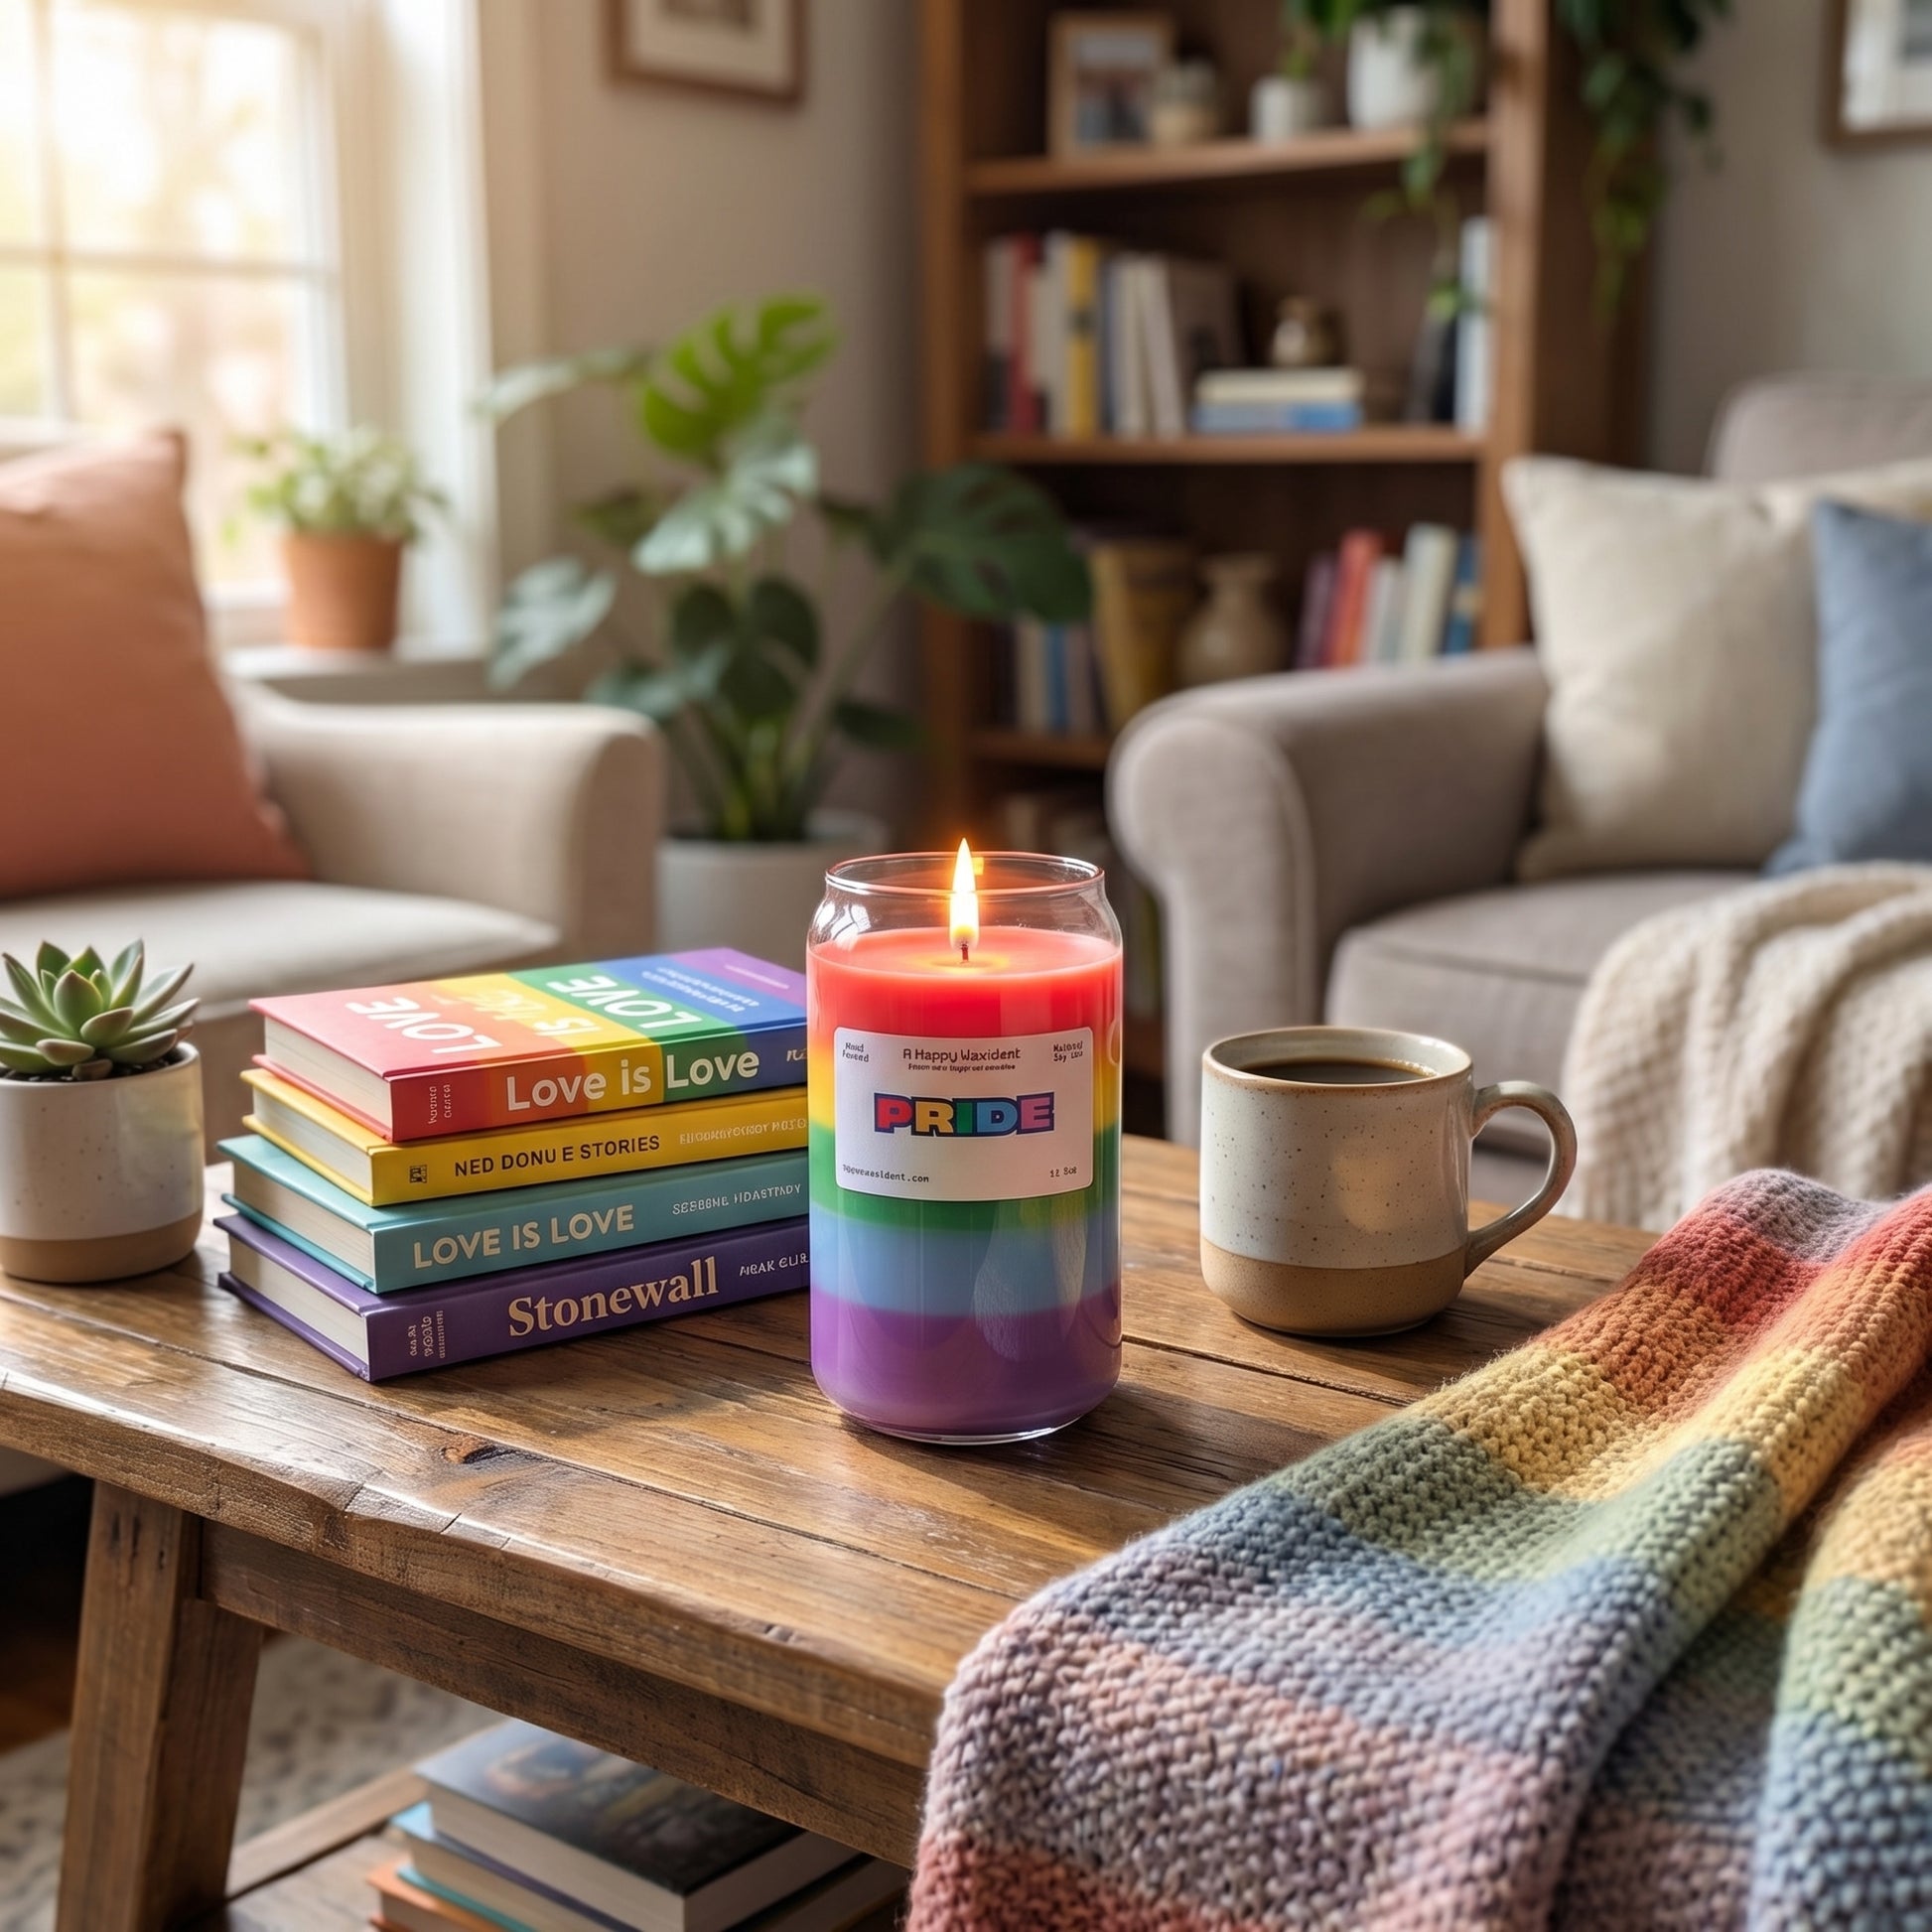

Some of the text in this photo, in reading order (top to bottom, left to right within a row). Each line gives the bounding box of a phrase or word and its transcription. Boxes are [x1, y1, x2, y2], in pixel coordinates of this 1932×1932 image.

[345, 997, 503, 1054] LOVE
[546, 975, 703, 1030] LOVE
[505, 1072, 607, 1111] Love
[620, 1058, 652, 1095] is
[666, 1050, 760, 1089] Love
[902, 1047, 1022, 1064] A Happy Waxident
[873, 1091, 1055, 1138] PRIDE
[455, 1157, 495, 1177] NED
[580, 1135, 661, 1161] STORIES
[413, 1203, 635, 1270] LOVE IS LOVE
[507, 1255, 720, 1338] Stonewall
